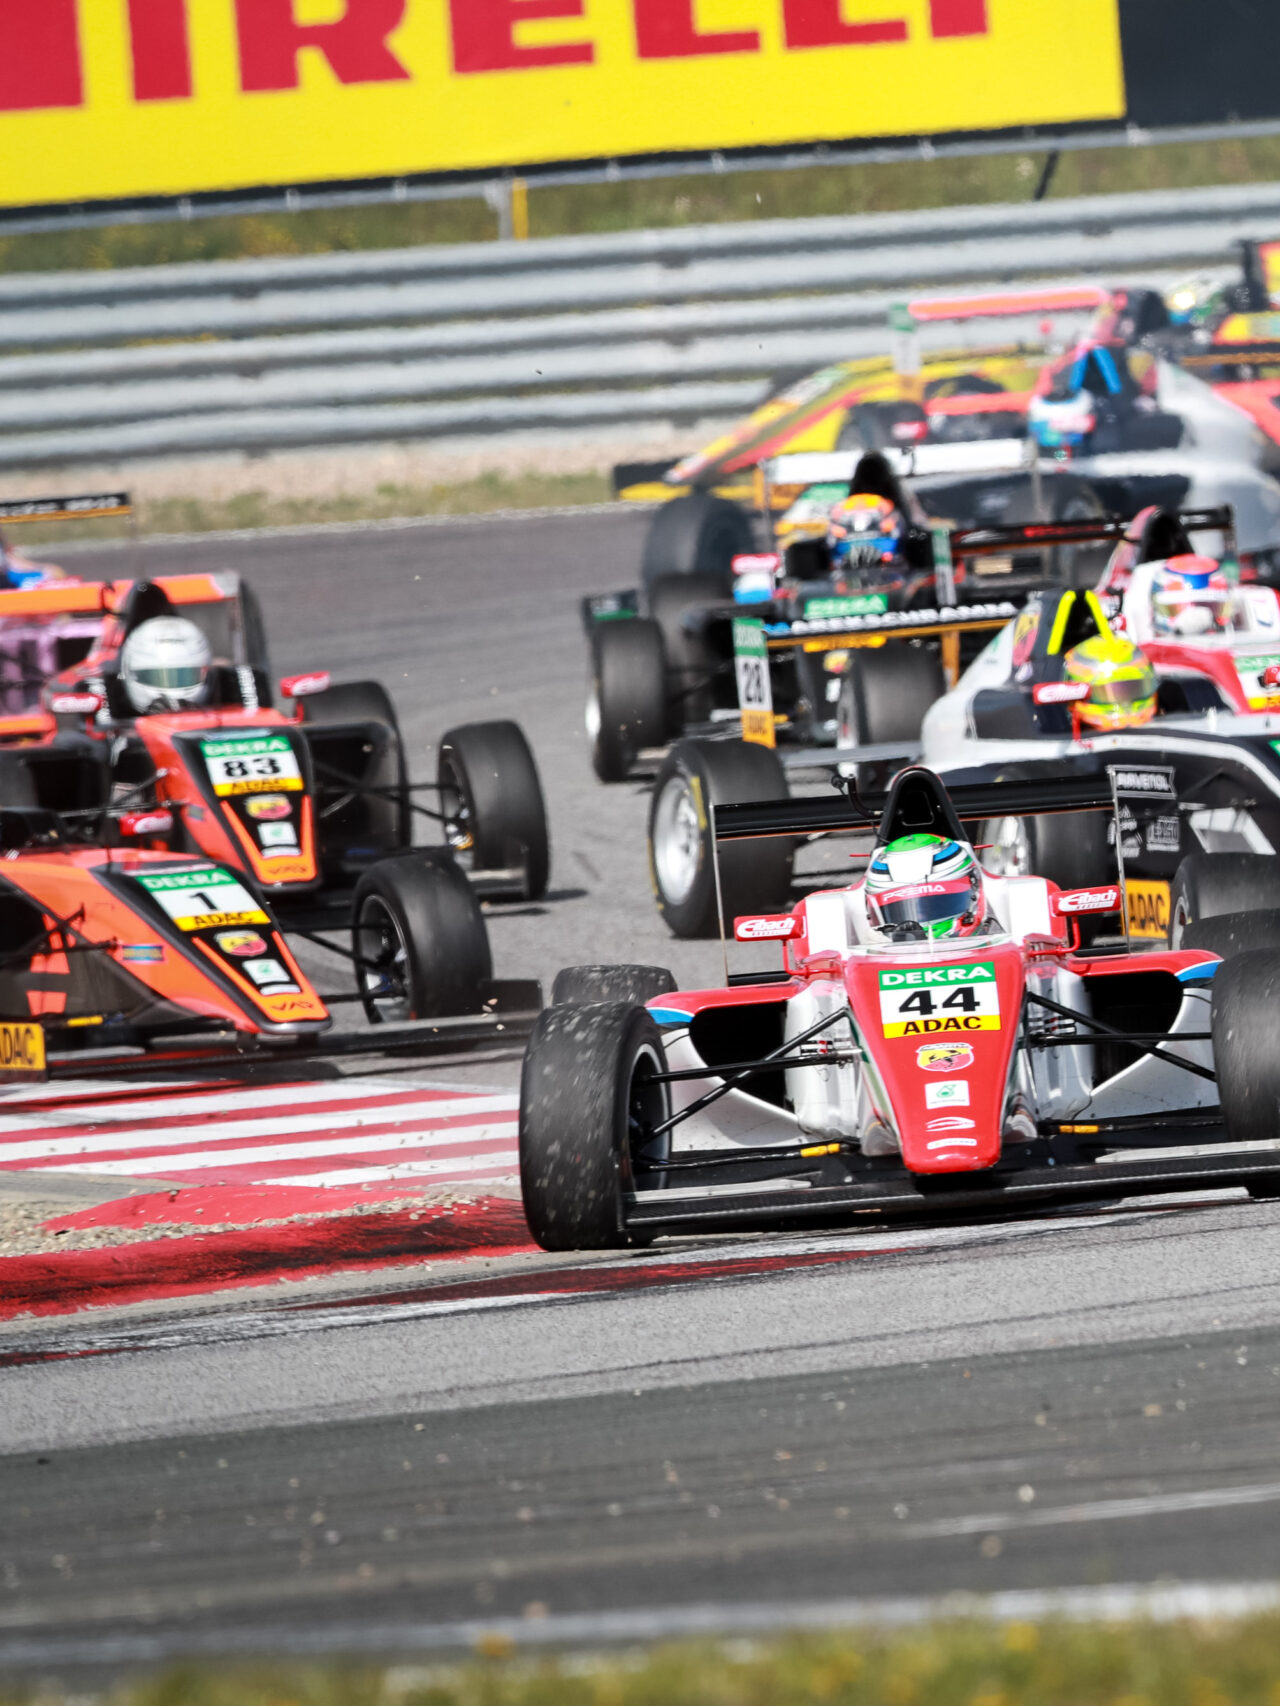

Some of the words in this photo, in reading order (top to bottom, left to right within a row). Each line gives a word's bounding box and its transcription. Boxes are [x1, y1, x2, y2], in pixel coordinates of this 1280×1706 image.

[223, 757, 281, 778] 83
[144, 871, 231, 889] DEKRA
[189, 892, 220, 911] 1
[1059, 889, 1119, 912] Eibach
[193, 911, 256, 927] ADAC
[1129, 891, 1168, 931] ADAC
[736, 916, 797, 938] Eibach
[881, 966, 993, 986] DEKRA
[898, 986, 981, 1016] 44
[902, 1016, 983, 1036] ADAC
